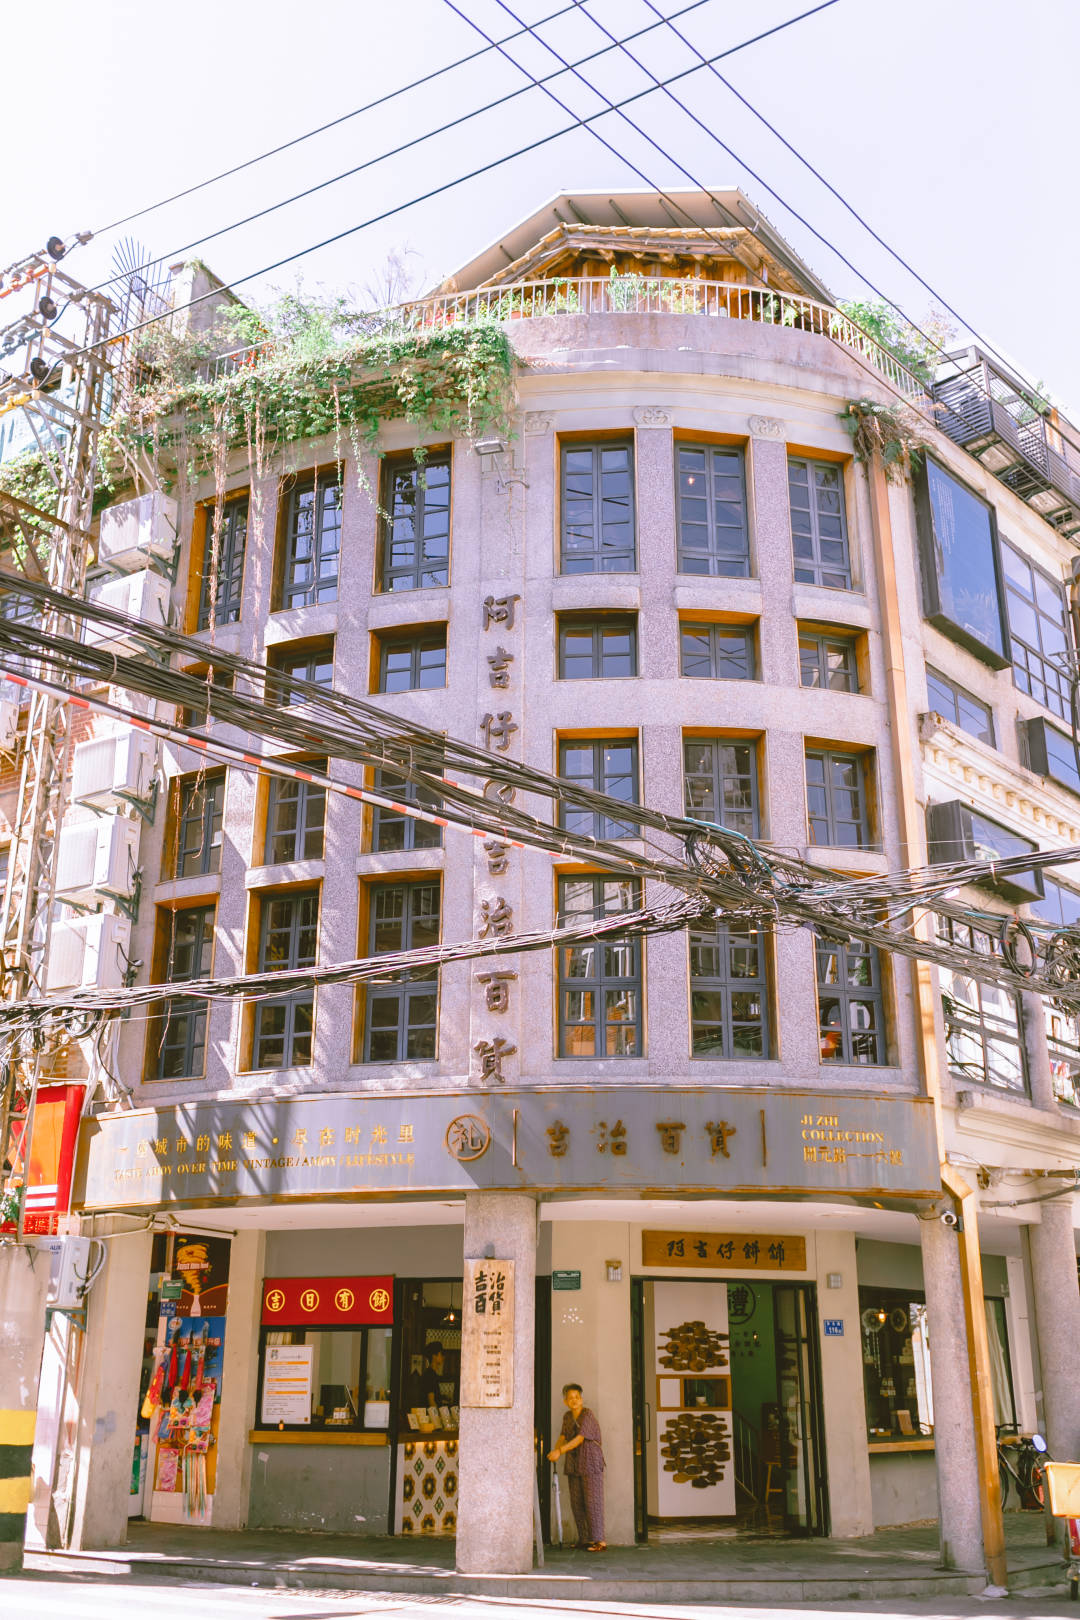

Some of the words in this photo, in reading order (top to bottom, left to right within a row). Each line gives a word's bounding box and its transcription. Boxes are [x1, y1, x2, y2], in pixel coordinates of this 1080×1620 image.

[480, 593, 521, 751] 阿吉仔
[473, 840, 519, 1084] 吉治百貨
[800, 1114, 813, 1126] JI
[816, 1115, 839, 1127] ZHI
[545, 1119, 736, 1158] 吉治百貨
[801, 1128, 884, 1143] COLLECTION
[146, 1164, 172, 1177] AMOY
[177, 1162, 206, 1174] OVER
[211, 1160, 238, 1172] TIME
[271, 1291, 387, 1309] 吉日有餅
